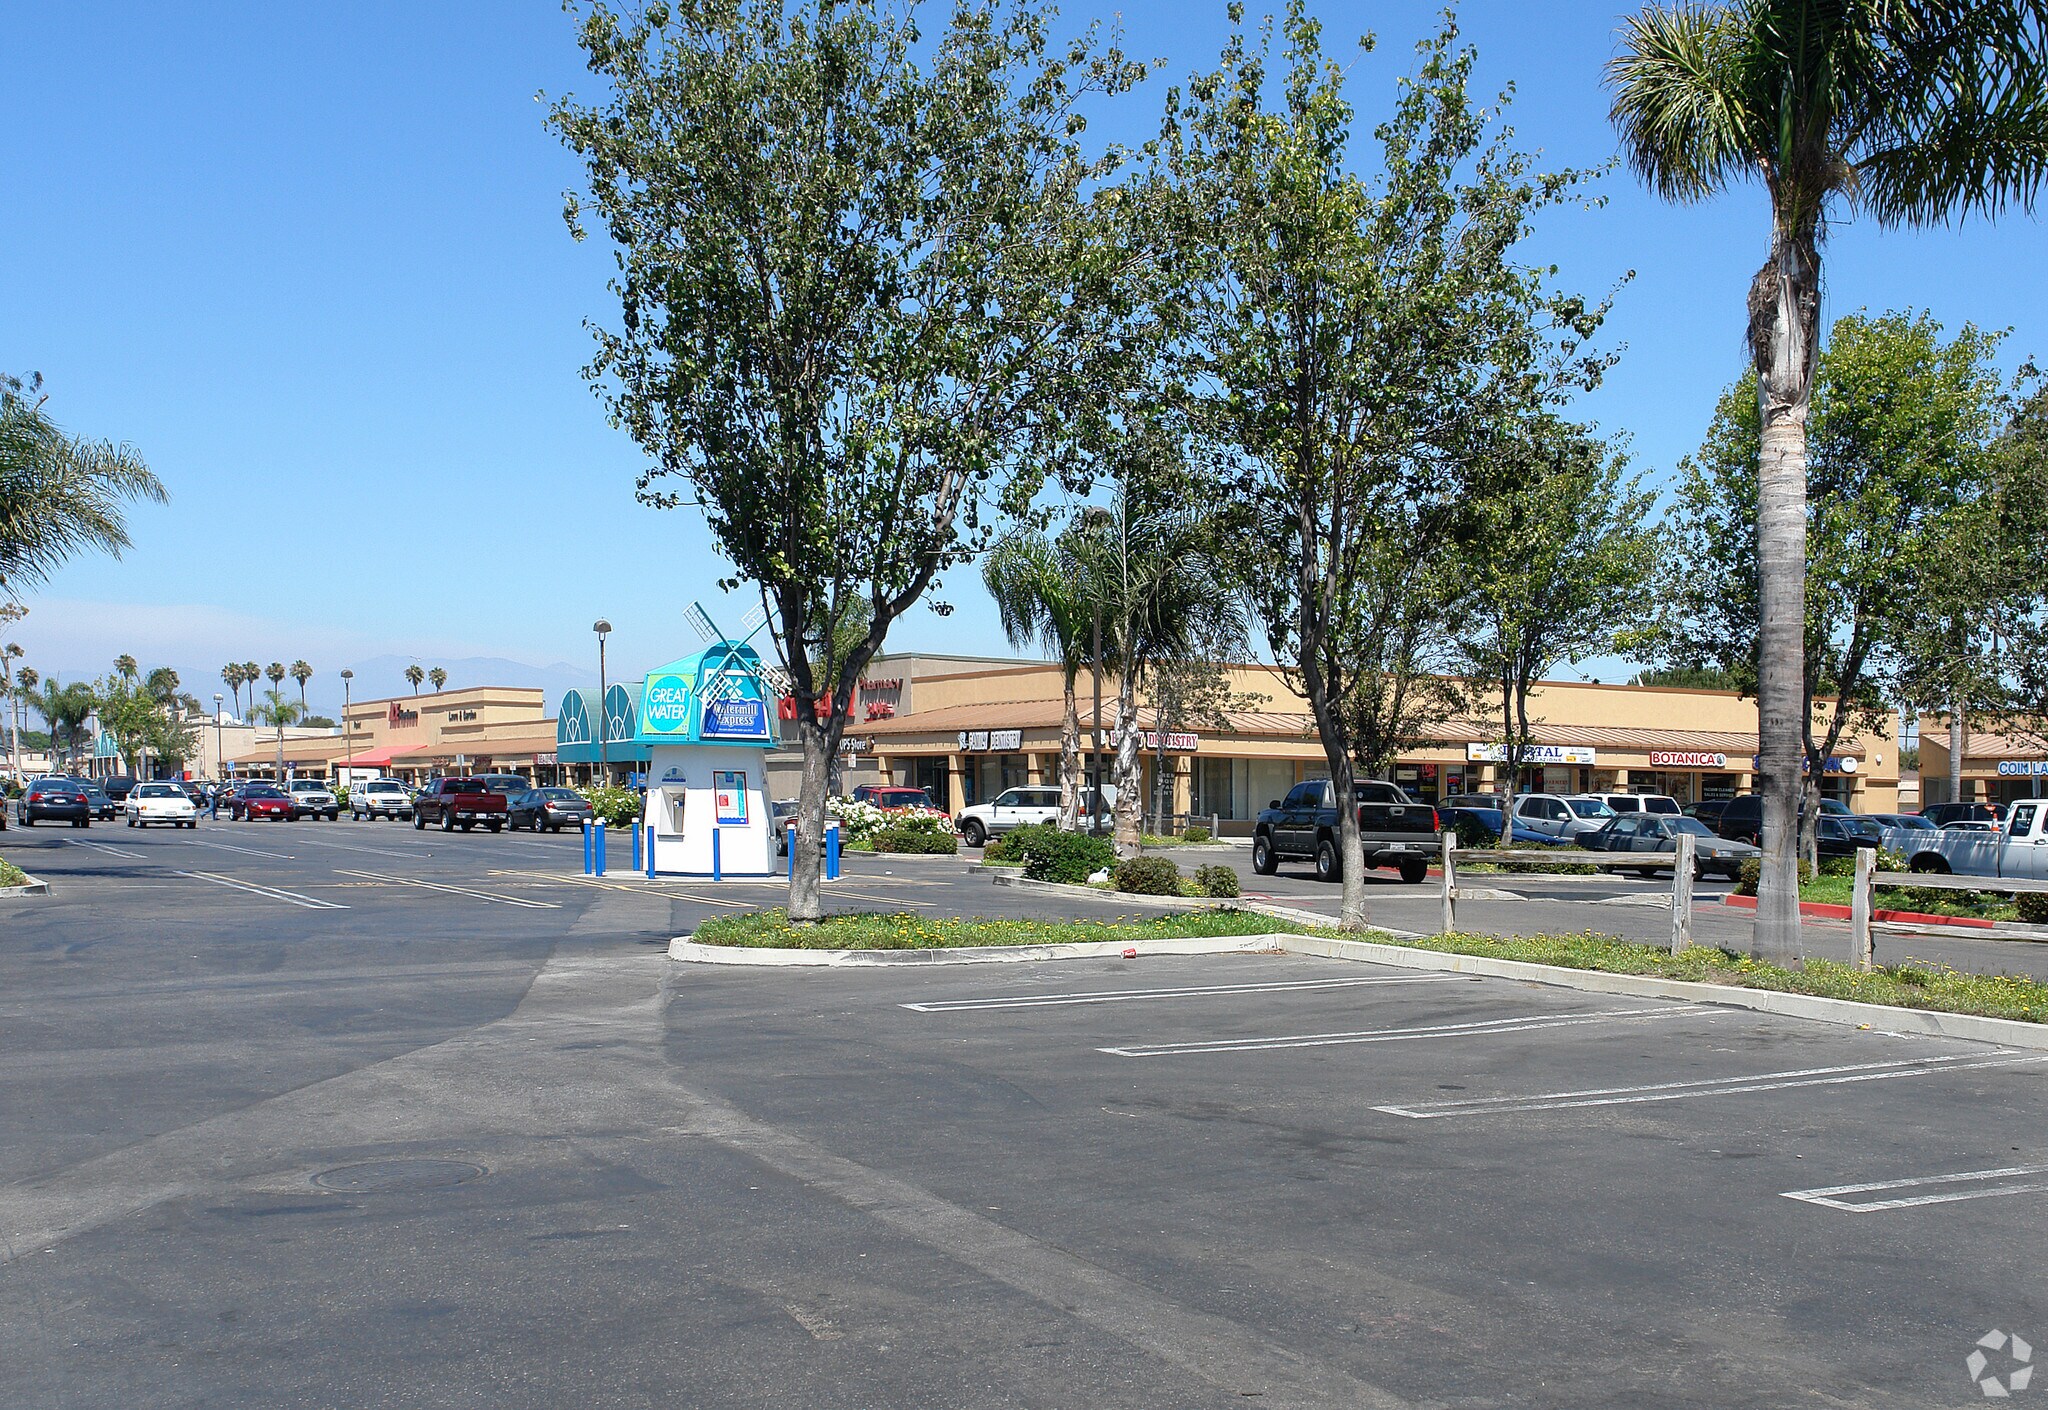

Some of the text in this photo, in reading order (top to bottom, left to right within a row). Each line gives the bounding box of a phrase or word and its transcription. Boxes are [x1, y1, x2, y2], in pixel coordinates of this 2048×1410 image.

[650, 688, 688, 703] GREAT
[648, 704, 687, 720] WATER
[717, 713, 755, 727] Express
[839, 738, 866, 751] UPS Store
[990, 730, 1021, 749] DENTISTRY
[1147, 732, 1197, 748] DETISTRY
[1652, 753, 1715, 765] BOTANICA
[1999, 762, 2029, 774] COIN
